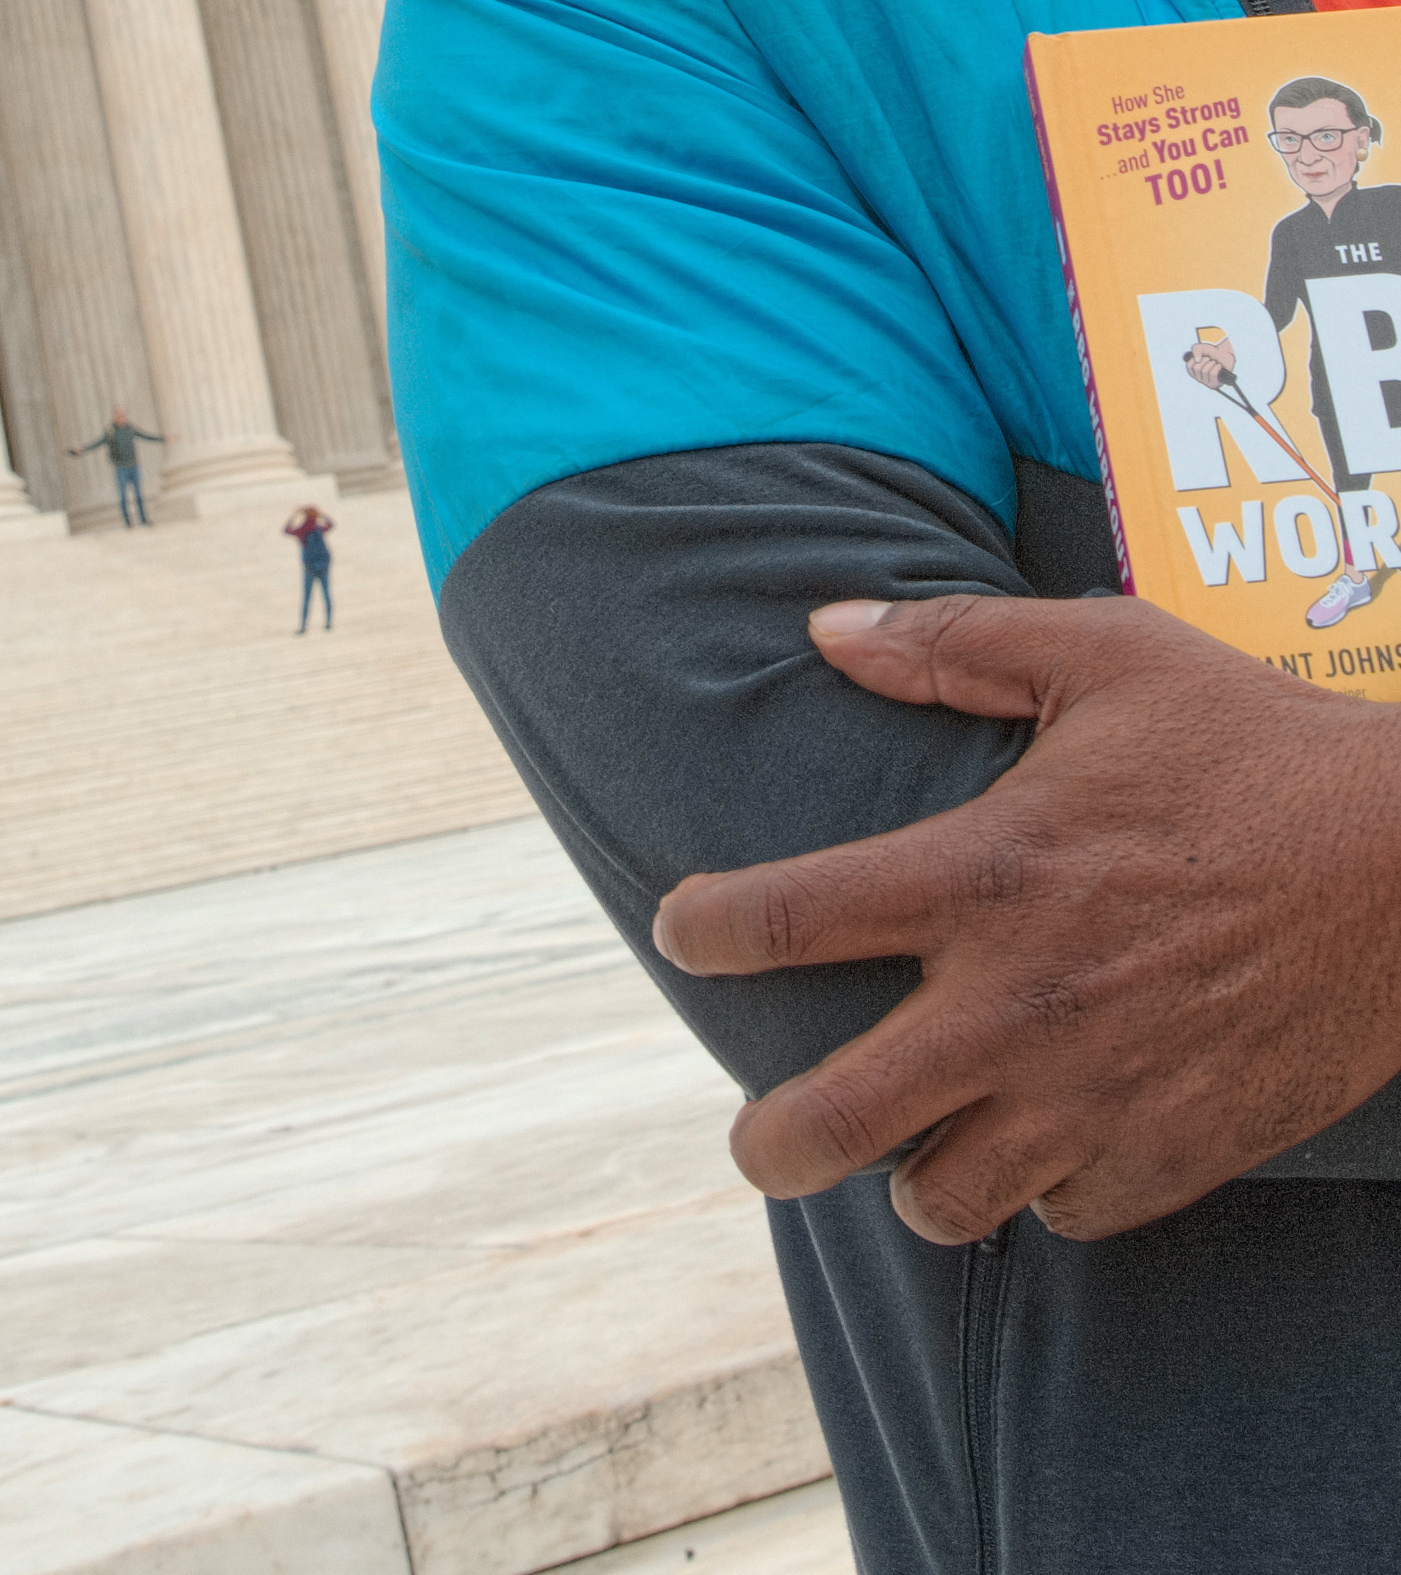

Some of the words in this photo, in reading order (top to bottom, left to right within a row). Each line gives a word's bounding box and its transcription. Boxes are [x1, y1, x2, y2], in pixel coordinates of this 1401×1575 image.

[1111, 94, 1148, 116] How
[1152, 84, 1185, 105] She
[1097, 116, 1161, 146] Stays
[1165, 96, 1241, 130] Strong
[1151, 138, 1198, 164] You
[1202, 125, 1249, 152] Can
[1144, 158, 1228, 206] TOO!
[1334, 242, 1383, 265] THE
